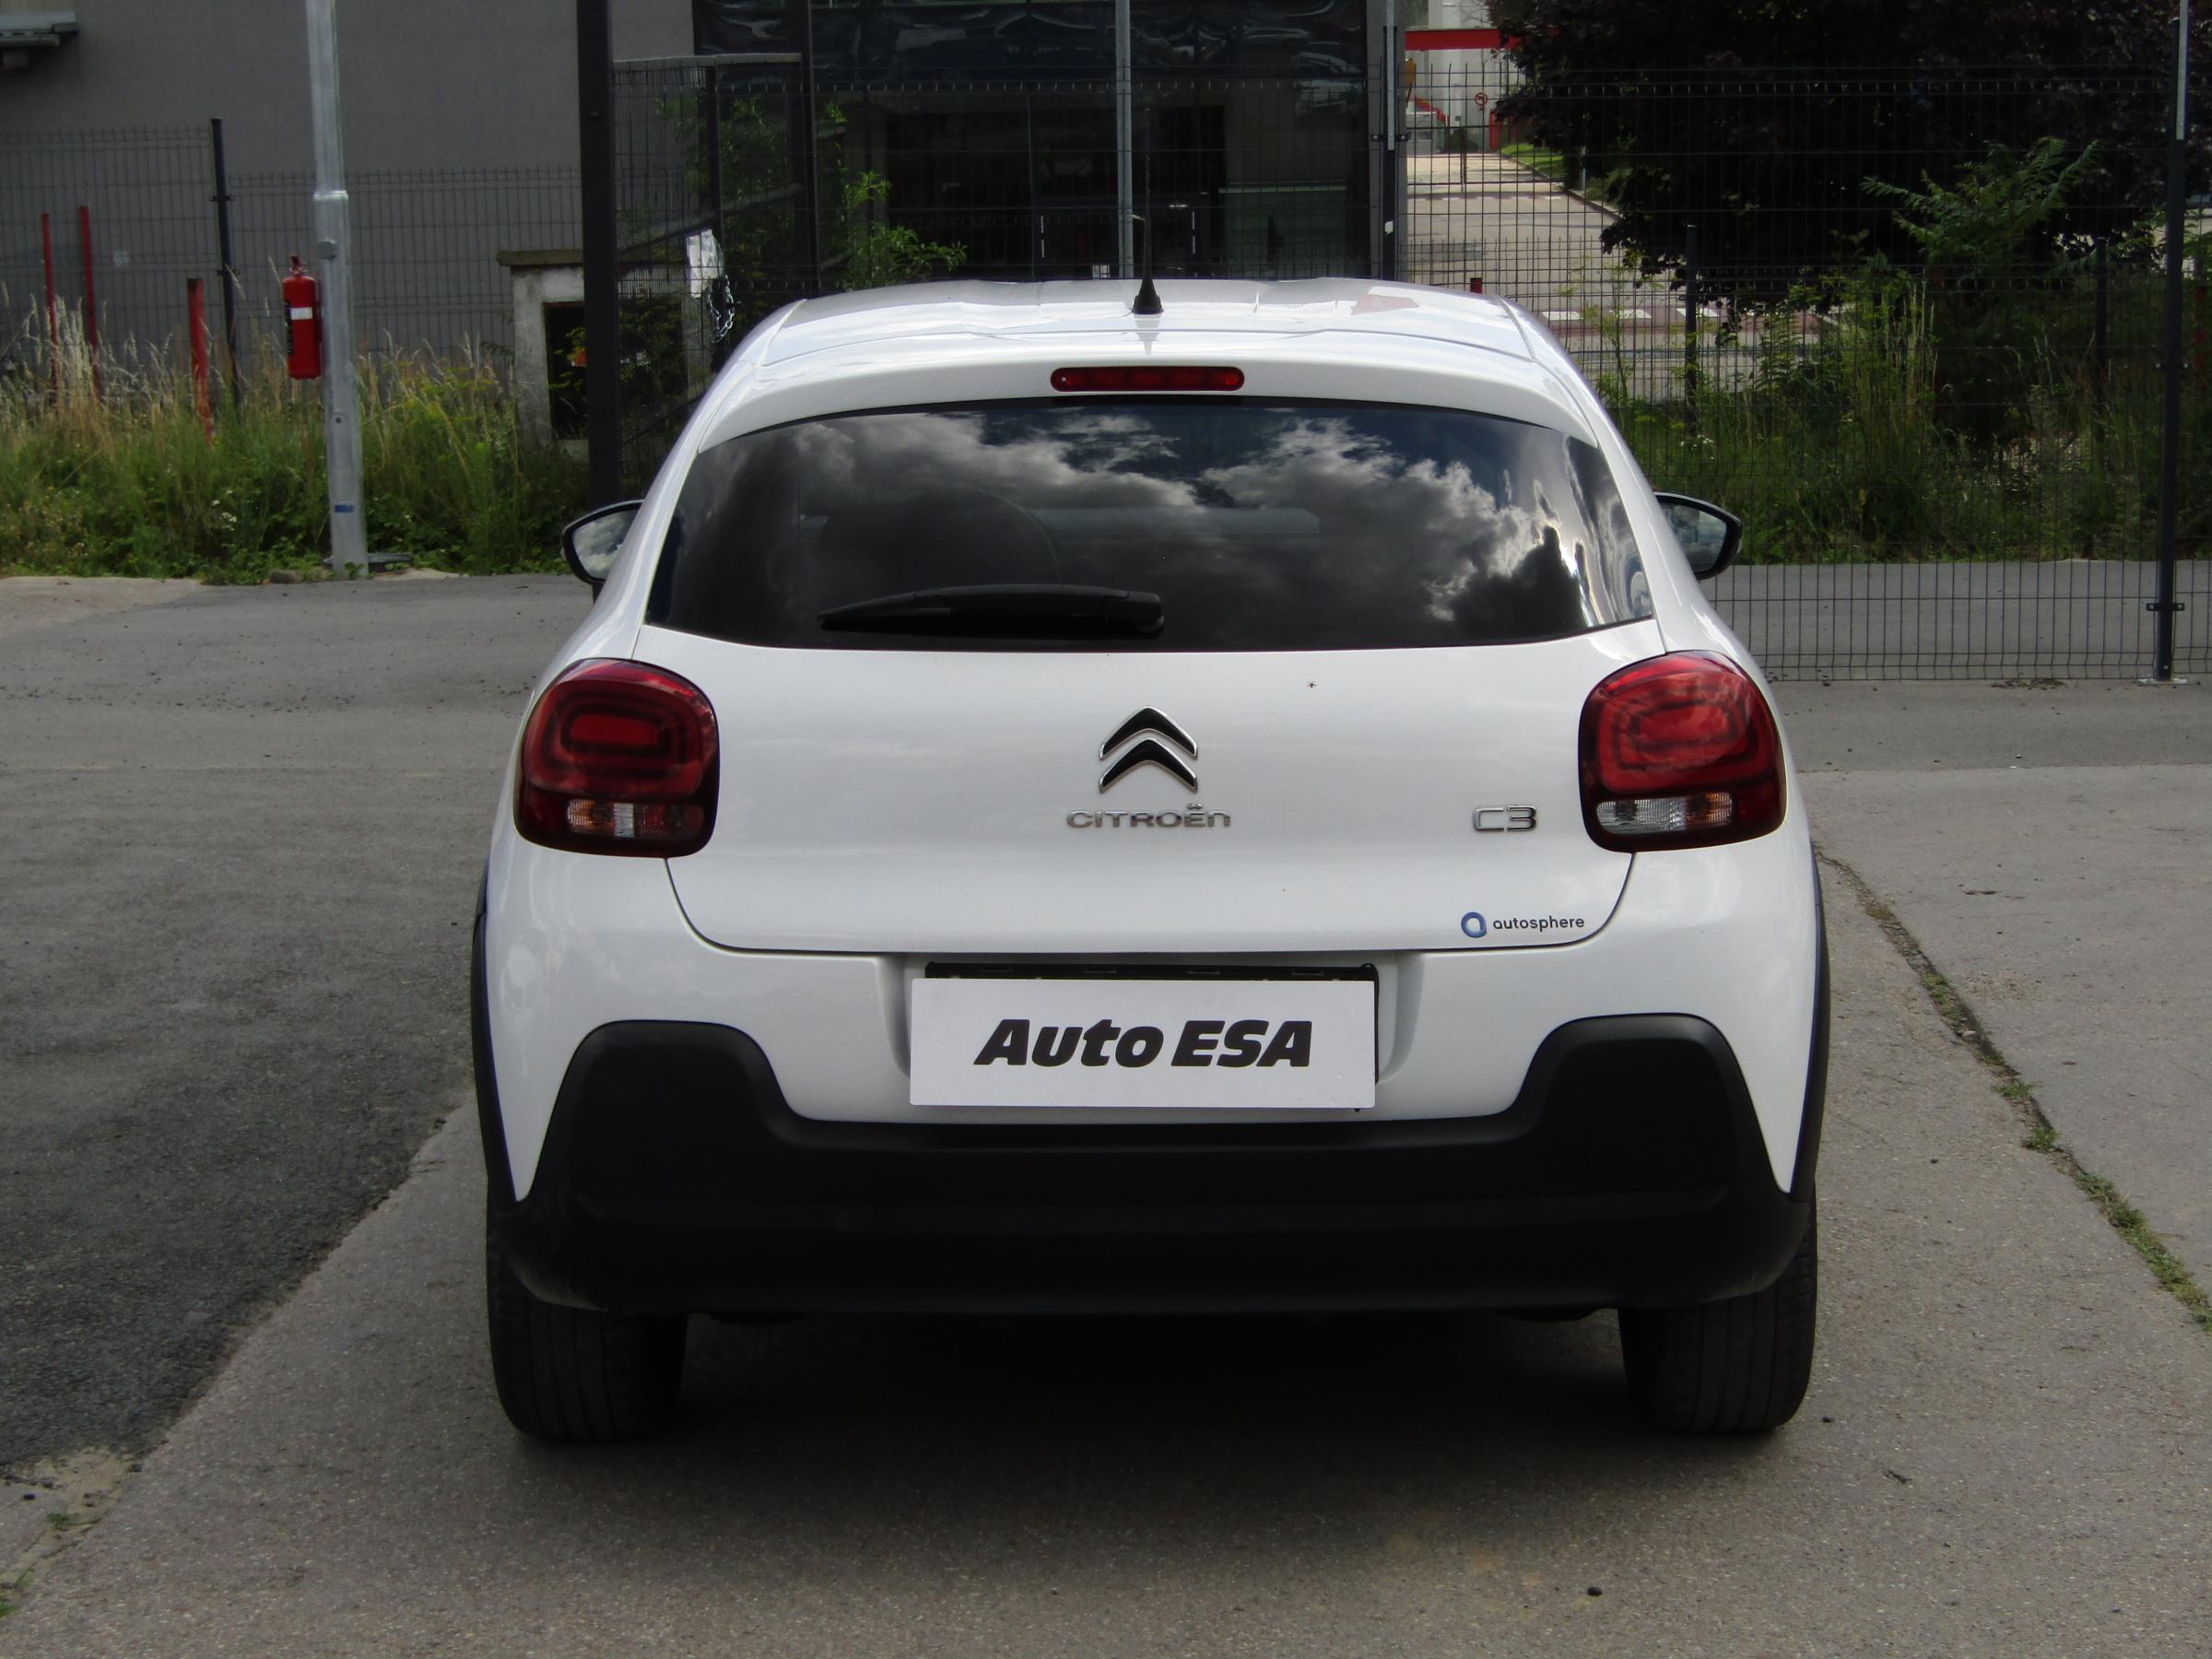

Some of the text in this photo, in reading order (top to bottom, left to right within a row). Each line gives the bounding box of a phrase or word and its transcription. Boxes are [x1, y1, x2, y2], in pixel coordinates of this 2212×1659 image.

[1473, 806, 1537, 832] C3
[1492, 915, 1585, 933] autosphere
[973, 1018, 1313, 1068] Auto ESA
